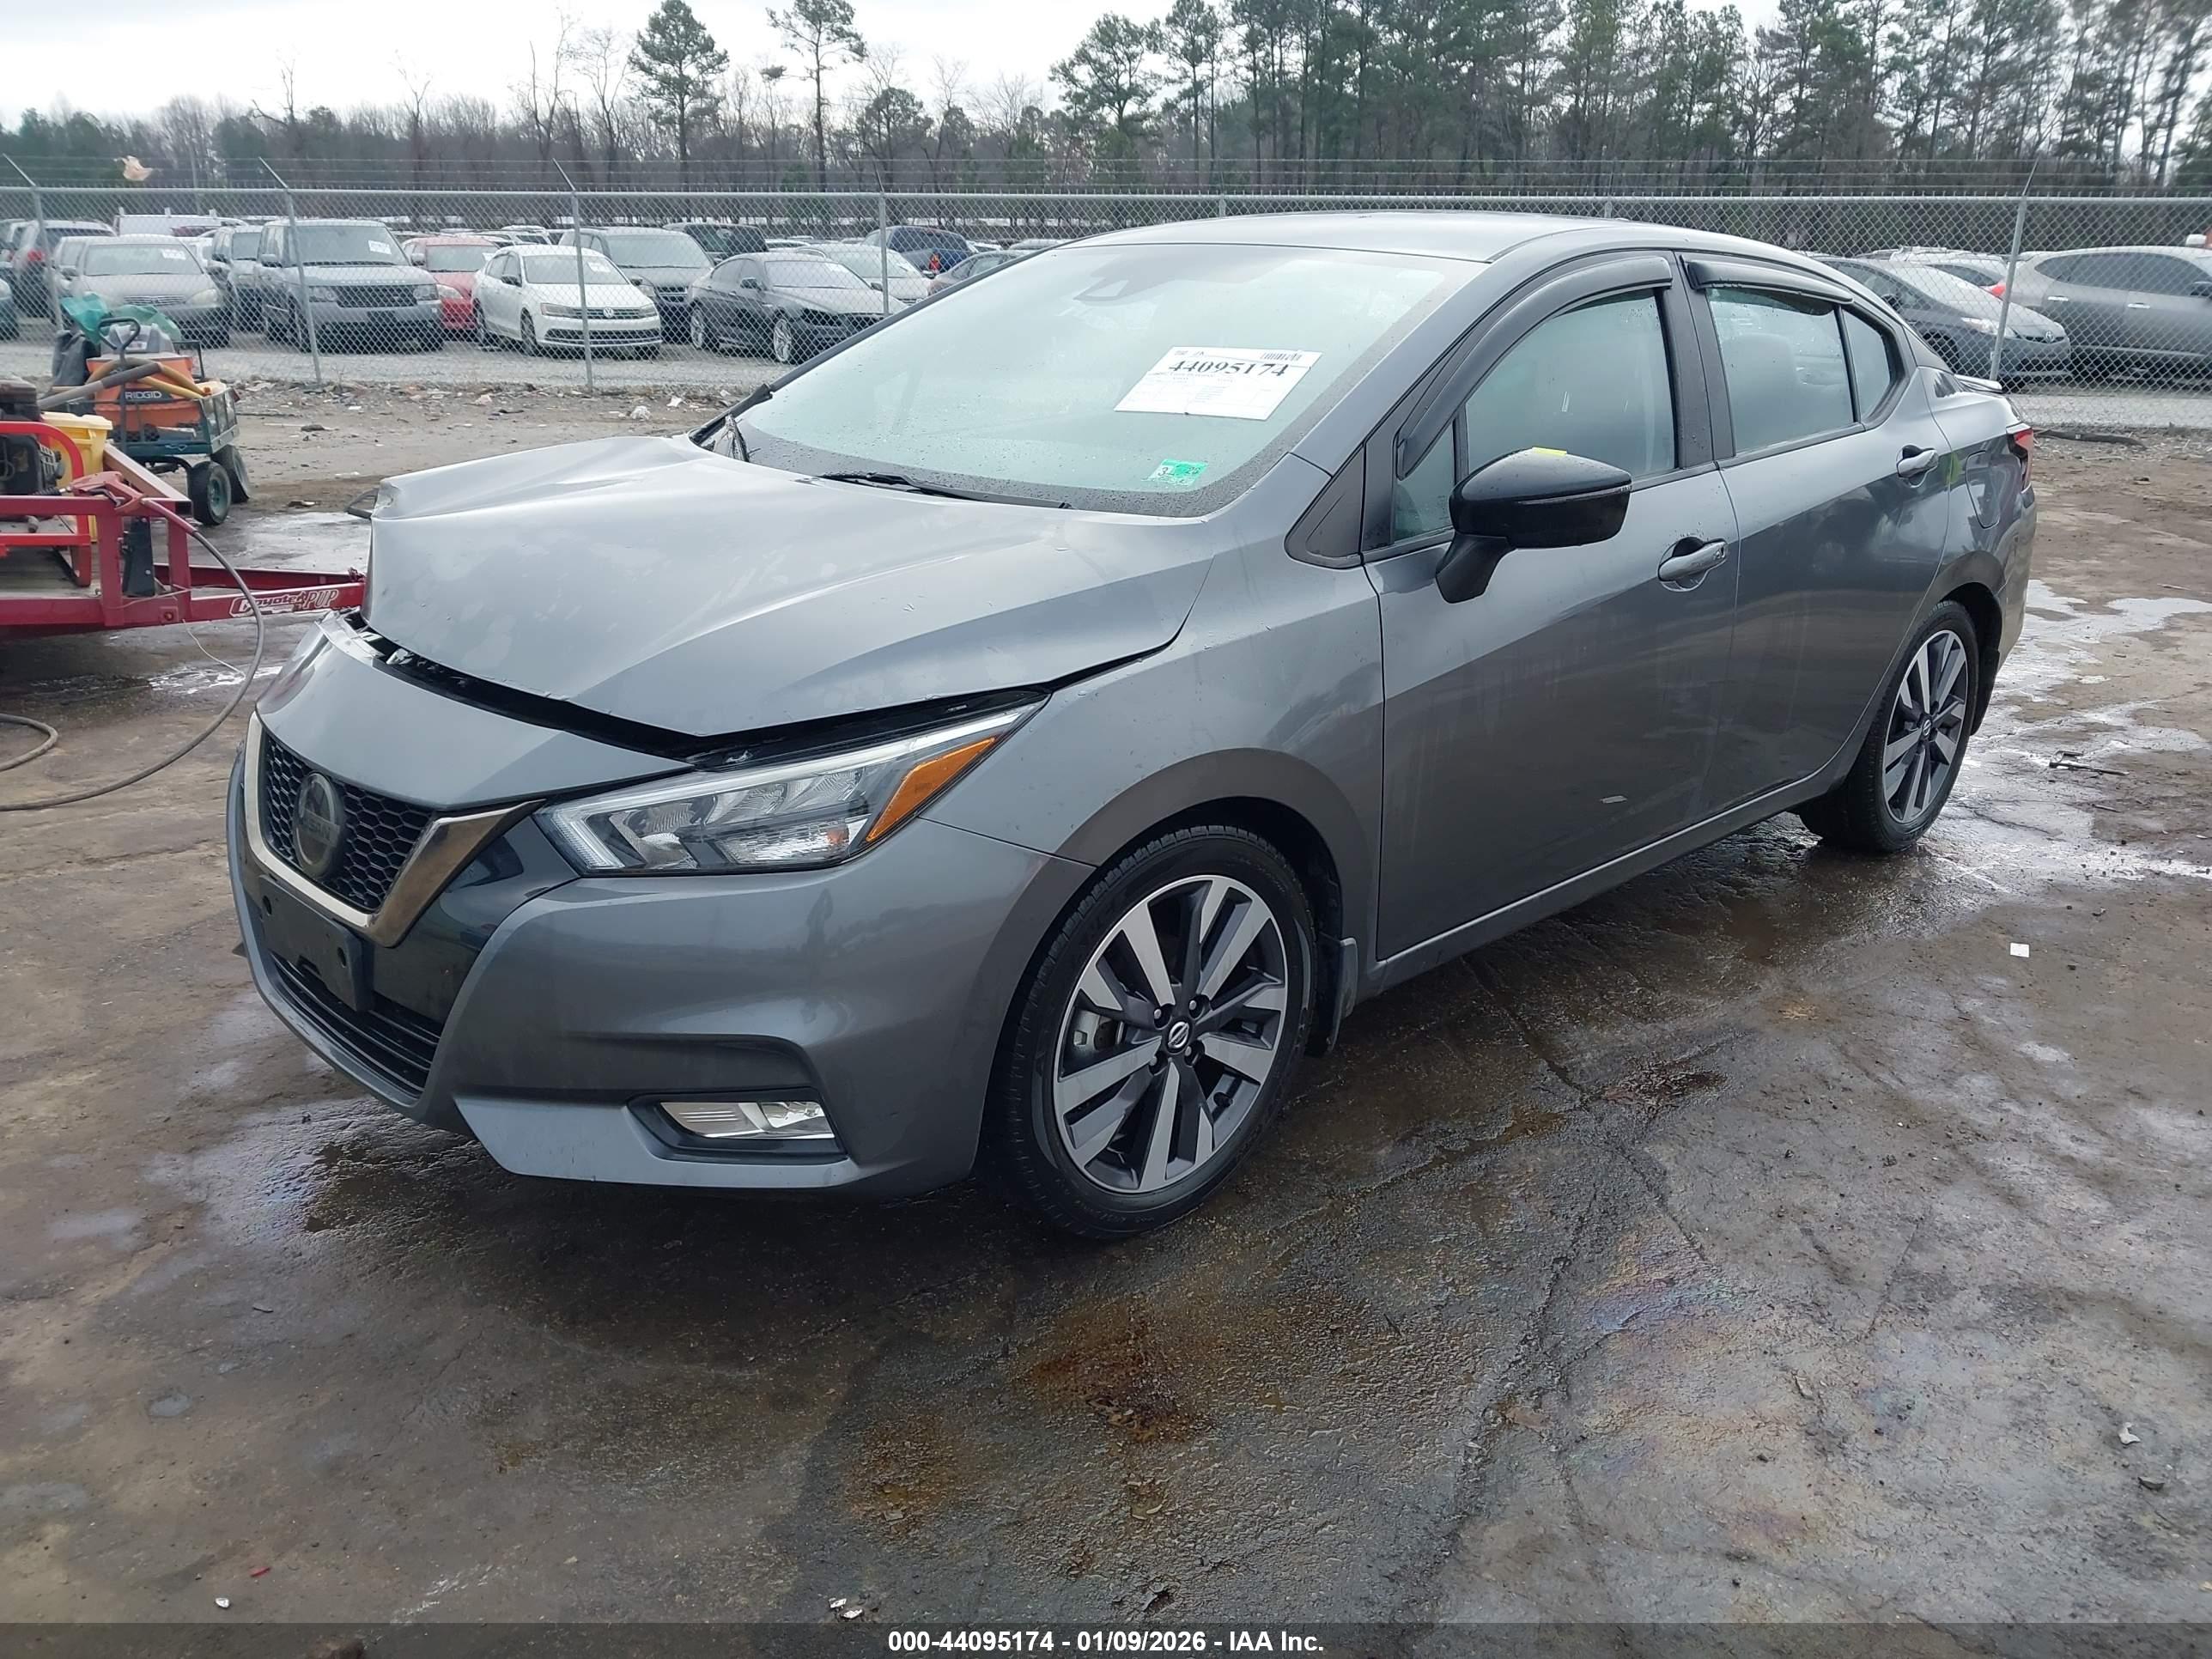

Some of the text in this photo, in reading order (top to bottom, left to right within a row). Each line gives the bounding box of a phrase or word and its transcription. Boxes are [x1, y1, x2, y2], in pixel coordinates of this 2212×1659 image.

[1168, 360, 1290, 376] 44095174
[125, 391, 162, 399] RIDGID
[302, 589, 339, 610] PUP
